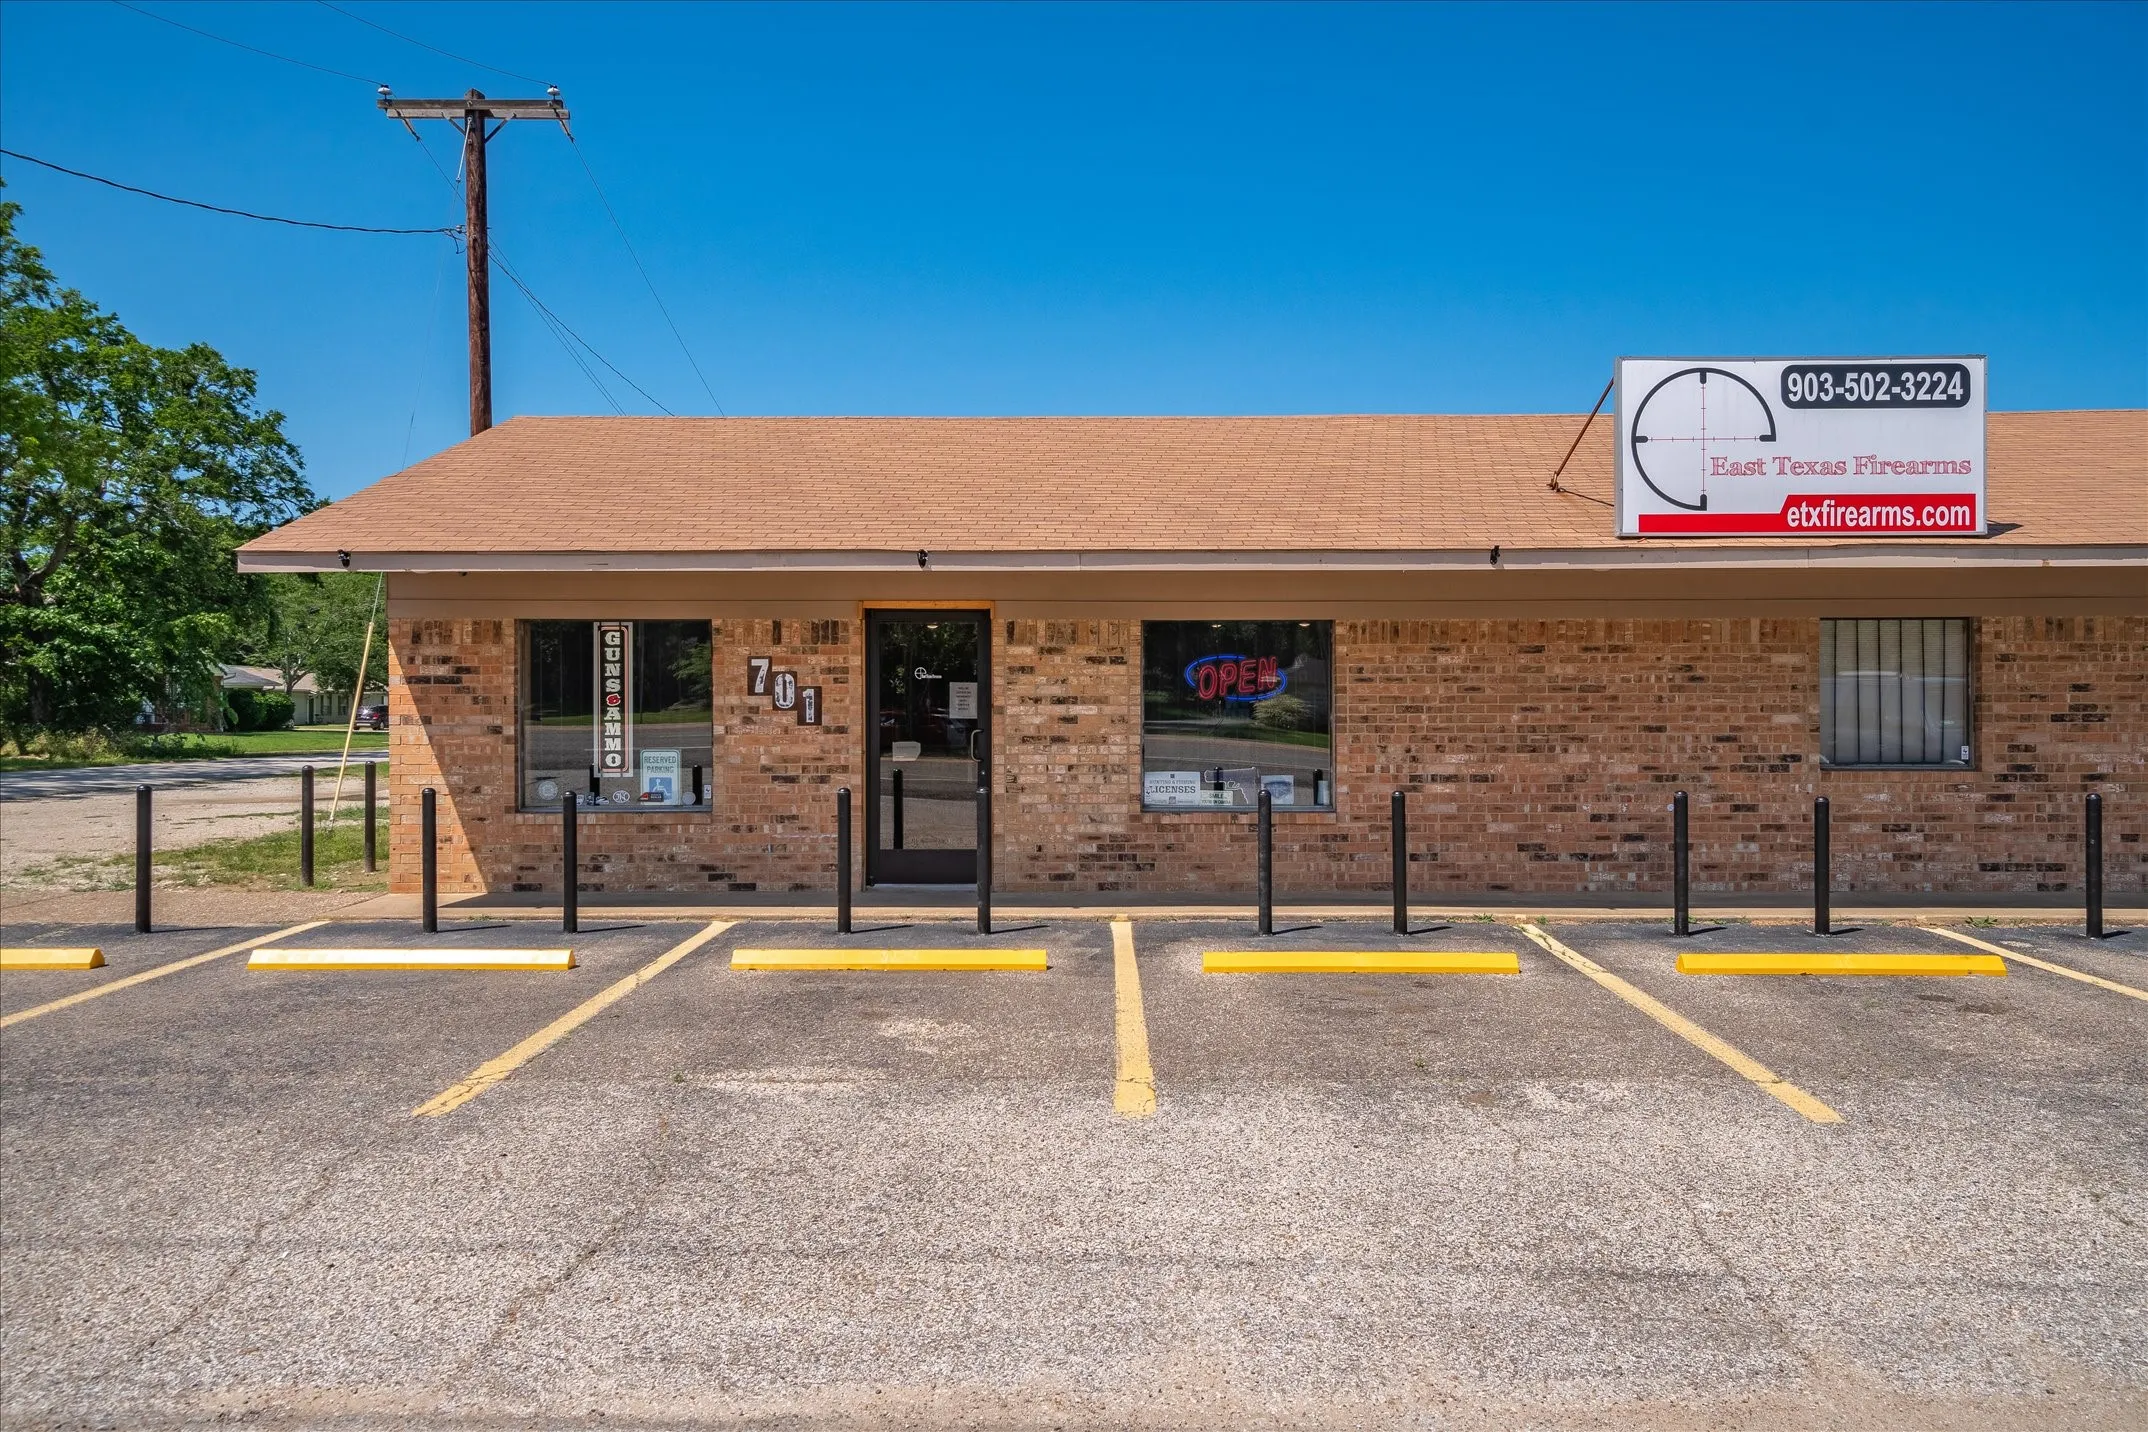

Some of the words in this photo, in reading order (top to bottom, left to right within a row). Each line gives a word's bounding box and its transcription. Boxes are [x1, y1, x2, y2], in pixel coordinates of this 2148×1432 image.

[1787, 371, 1964, 402] 903-502-3224
[1710, 456, 1767, 477] East
[1772, 456, 1848, 477] Texas
[1853, 454, 1972, 476] Firearms
[1786, 499, 1971, 528] etxfirearms.com
[604, 631, 621, 693] GUNS
[1198, 656, 1278, 700] OPEN
[604, 707, 622, 767] AMMO
[643, 755, 677, 764] RESERVED
[1149, 785, 1196, 794] LICENSES
